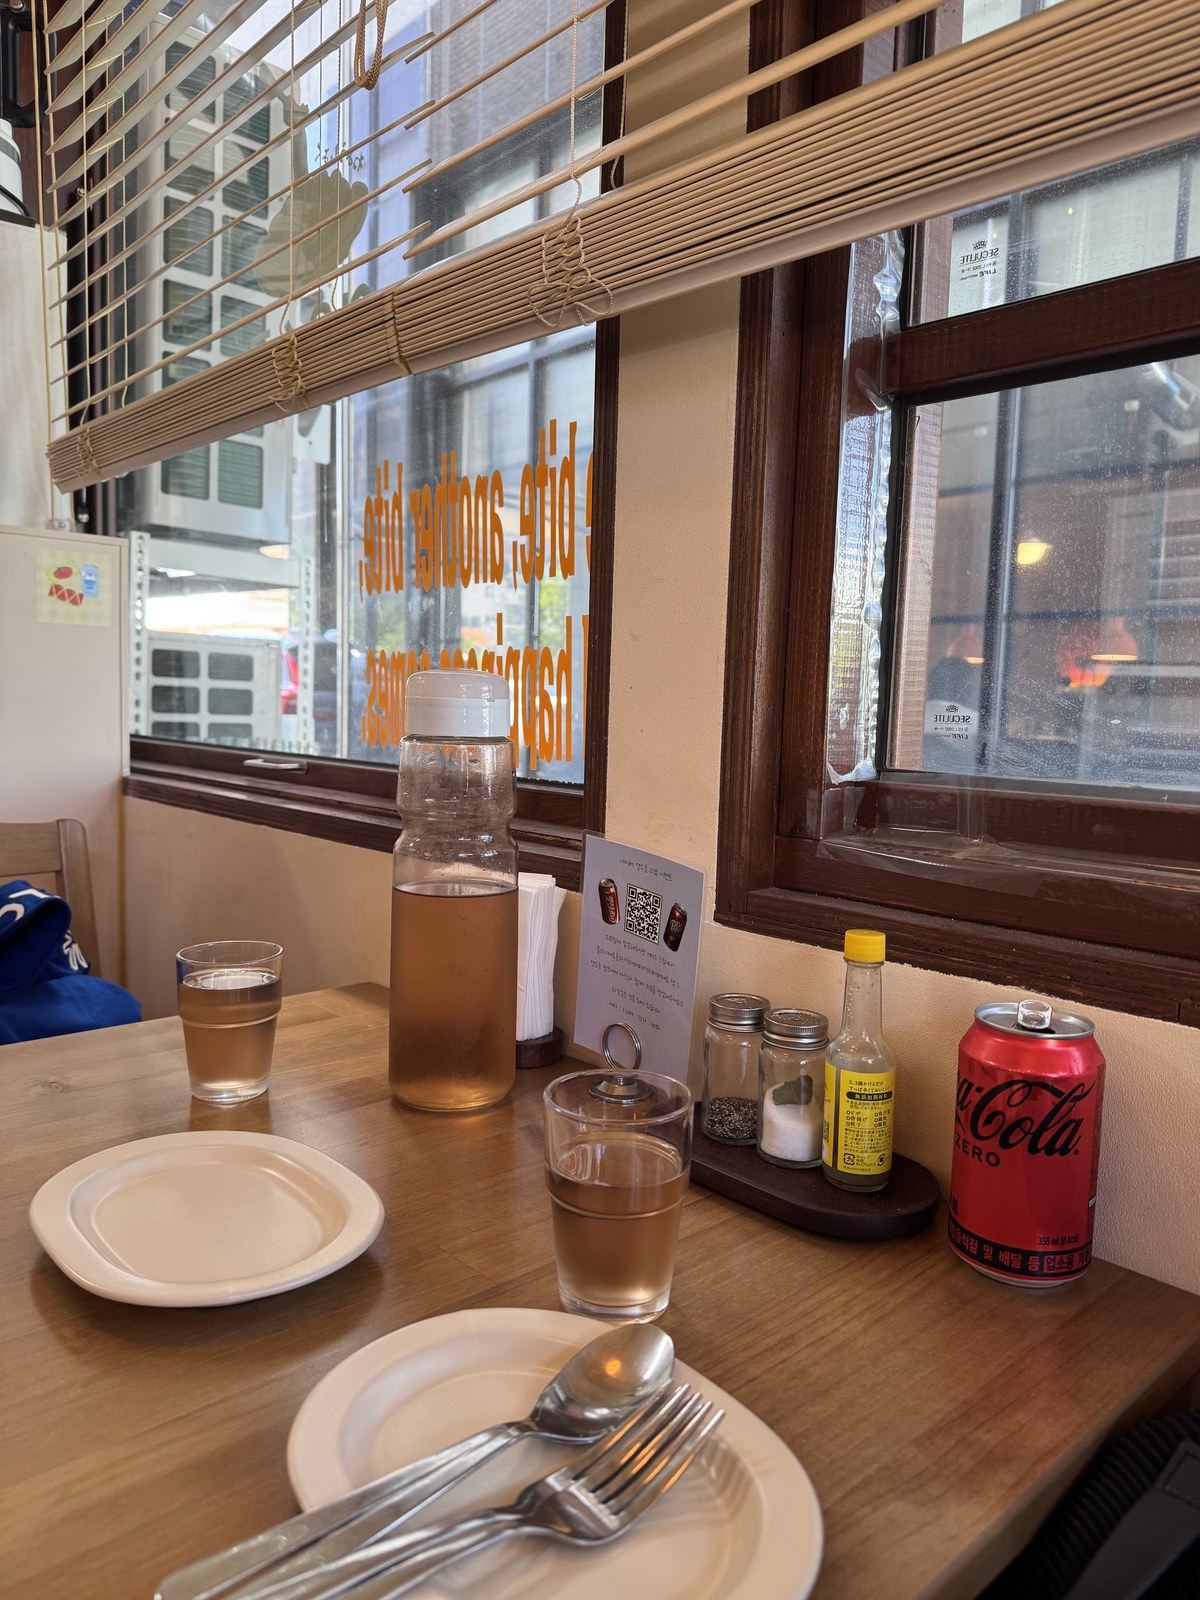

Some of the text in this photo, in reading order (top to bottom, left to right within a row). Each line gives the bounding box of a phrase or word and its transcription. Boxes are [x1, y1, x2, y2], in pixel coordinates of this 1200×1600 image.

[956, 1132, 1000, 1168] ZERO
[983, 1243, 993, 1261] 및
[999, 1249, 1023, 1268] 배달
[1028, 1255, 1040, 1271] 등
[1046, 1254, 1075, 1271] 업소용
